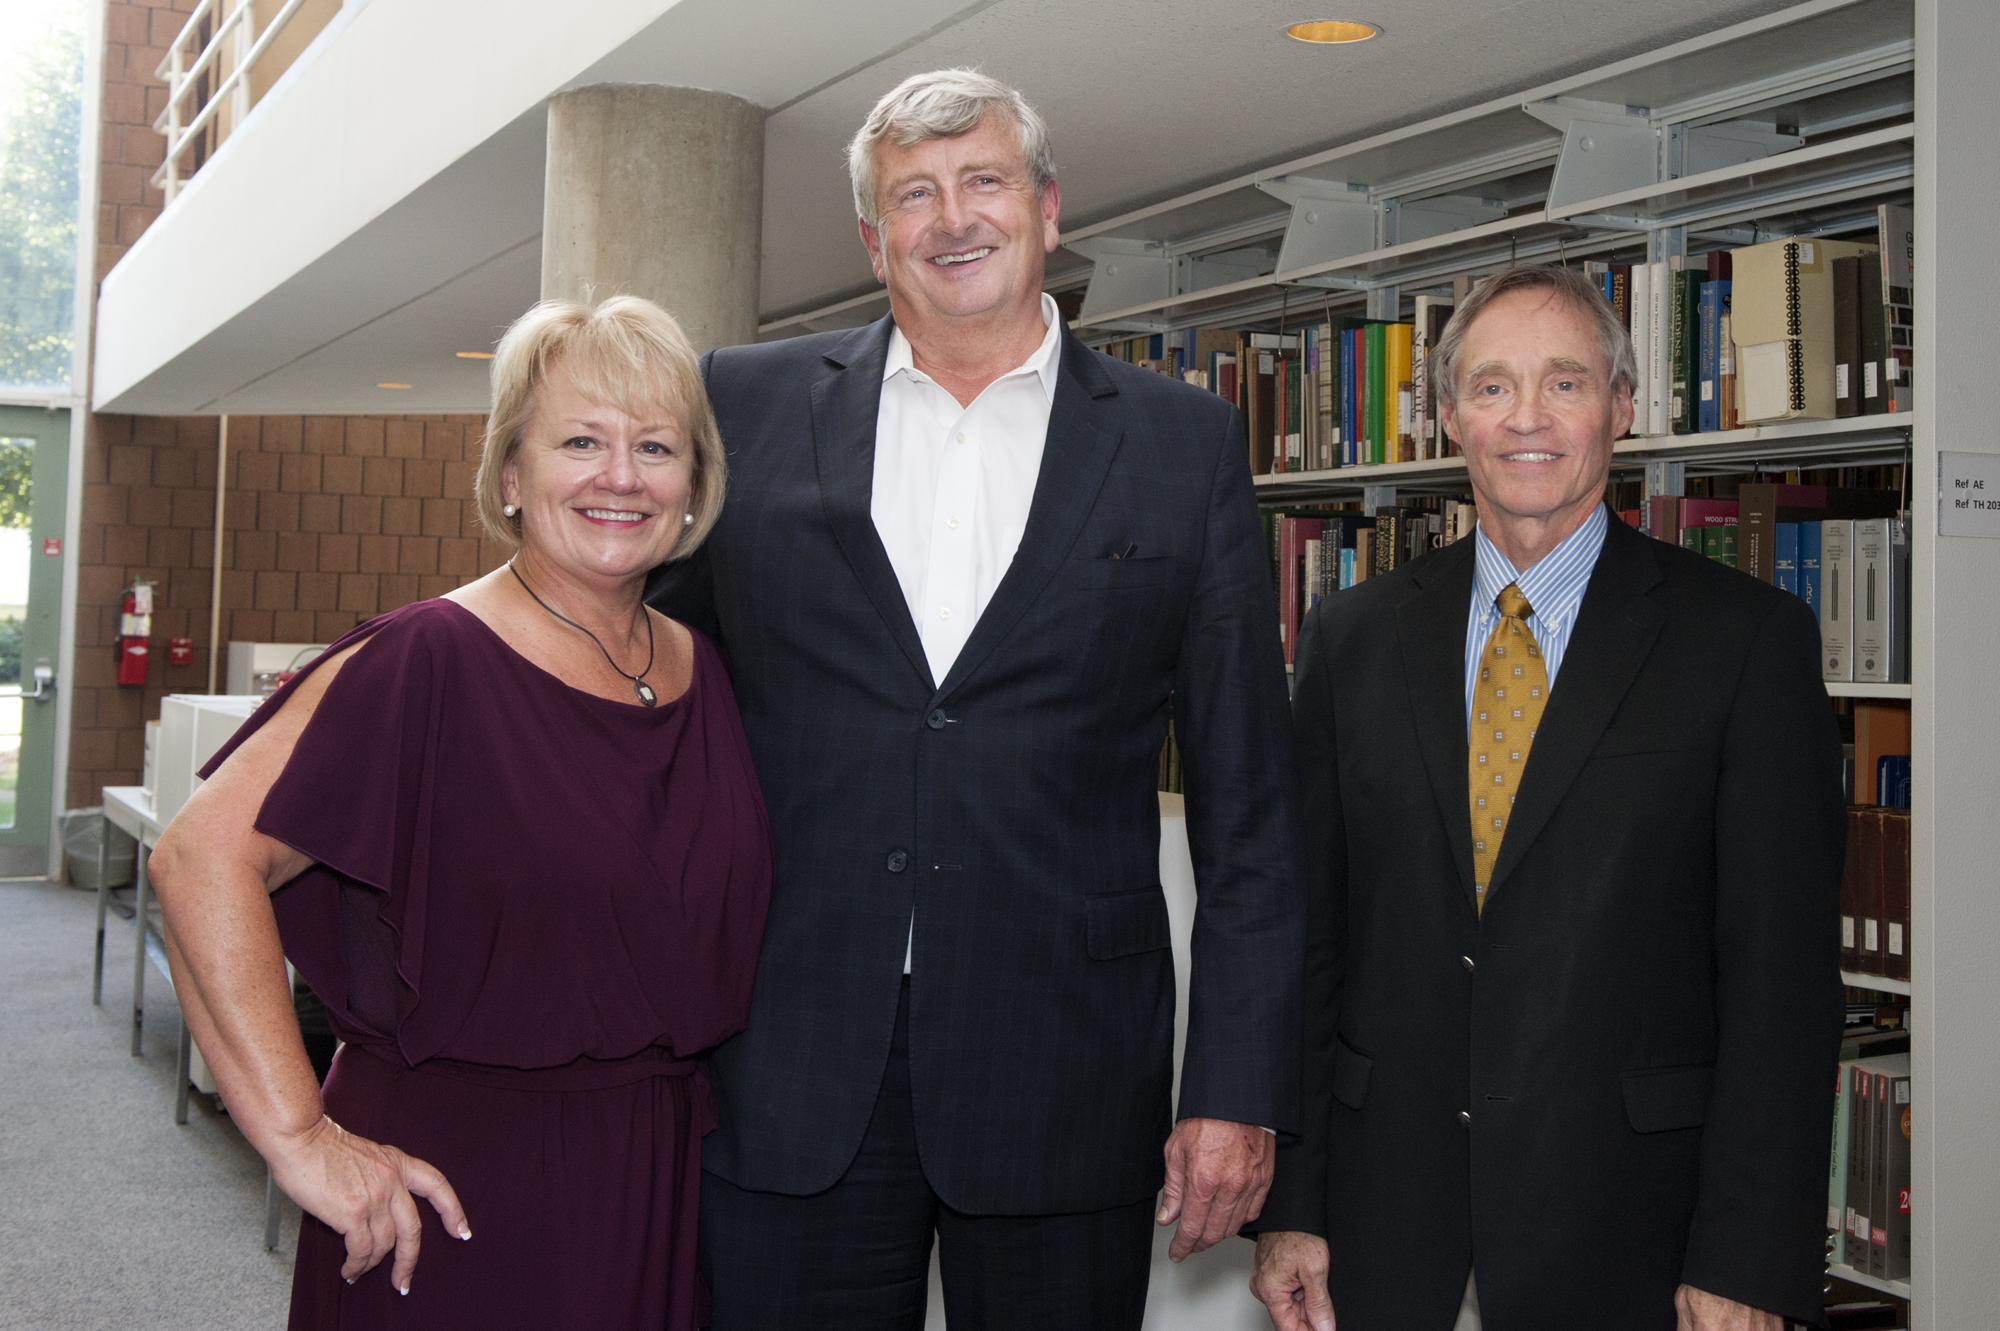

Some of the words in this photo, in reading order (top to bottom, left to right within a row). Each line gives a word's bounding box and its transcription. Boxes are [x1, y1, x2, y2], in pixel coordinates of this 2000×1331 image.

[1619, 274, 1624, 283] AN
[1674, 294, 1682, 357] GARDENS
[1955, 479, 1969, 488] Ref
[1973, 480, 1984, 489] AE
[1955, 500, 1969, 508] Ref
[1973, 500, 1984, 509] TH
[1872, 1229, 1885, 1242] 2000
